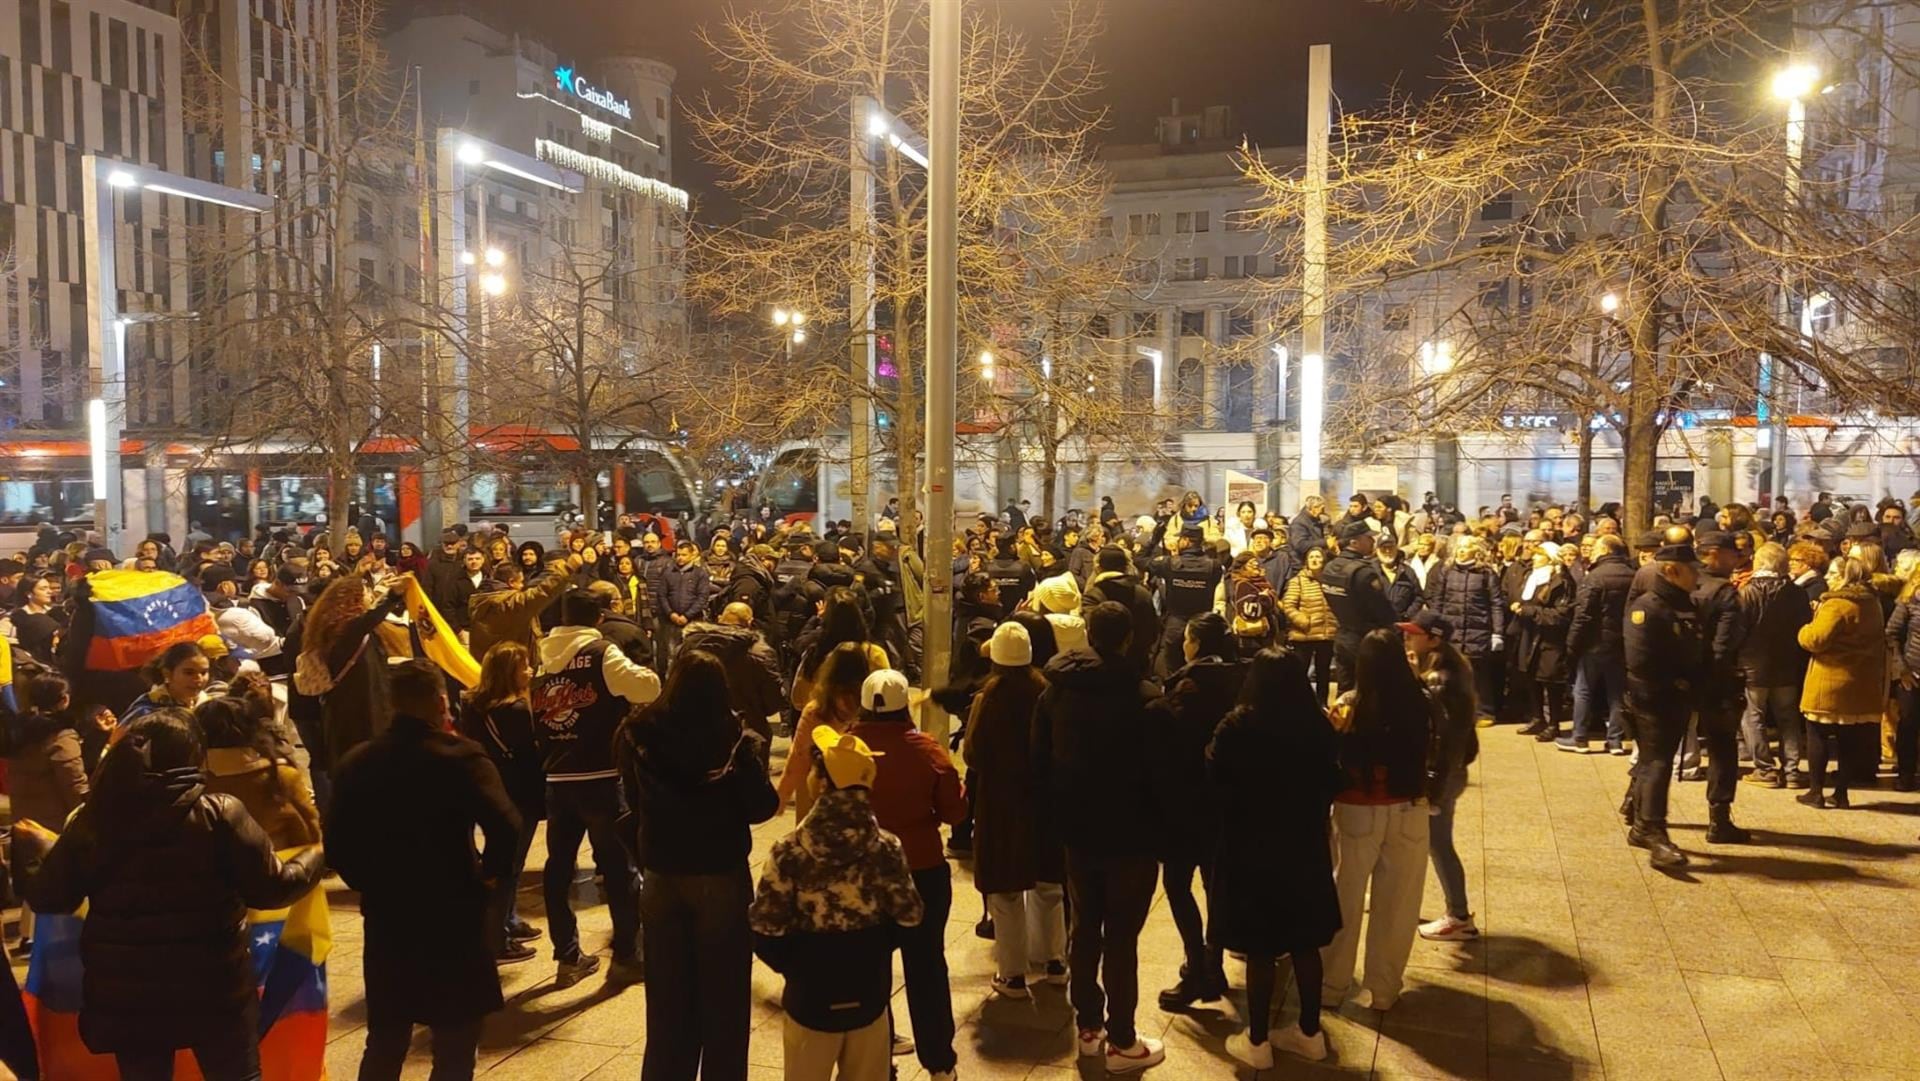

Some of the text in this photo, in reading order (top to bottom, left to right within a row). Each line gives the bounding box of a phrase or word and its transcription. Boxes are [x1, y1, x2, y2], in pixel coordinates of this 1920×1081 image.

[575, 76, 631, 120] CaixaBank
[1519, 415, 1558, 427] KFC
[565, 655, 592, 670] AGE
